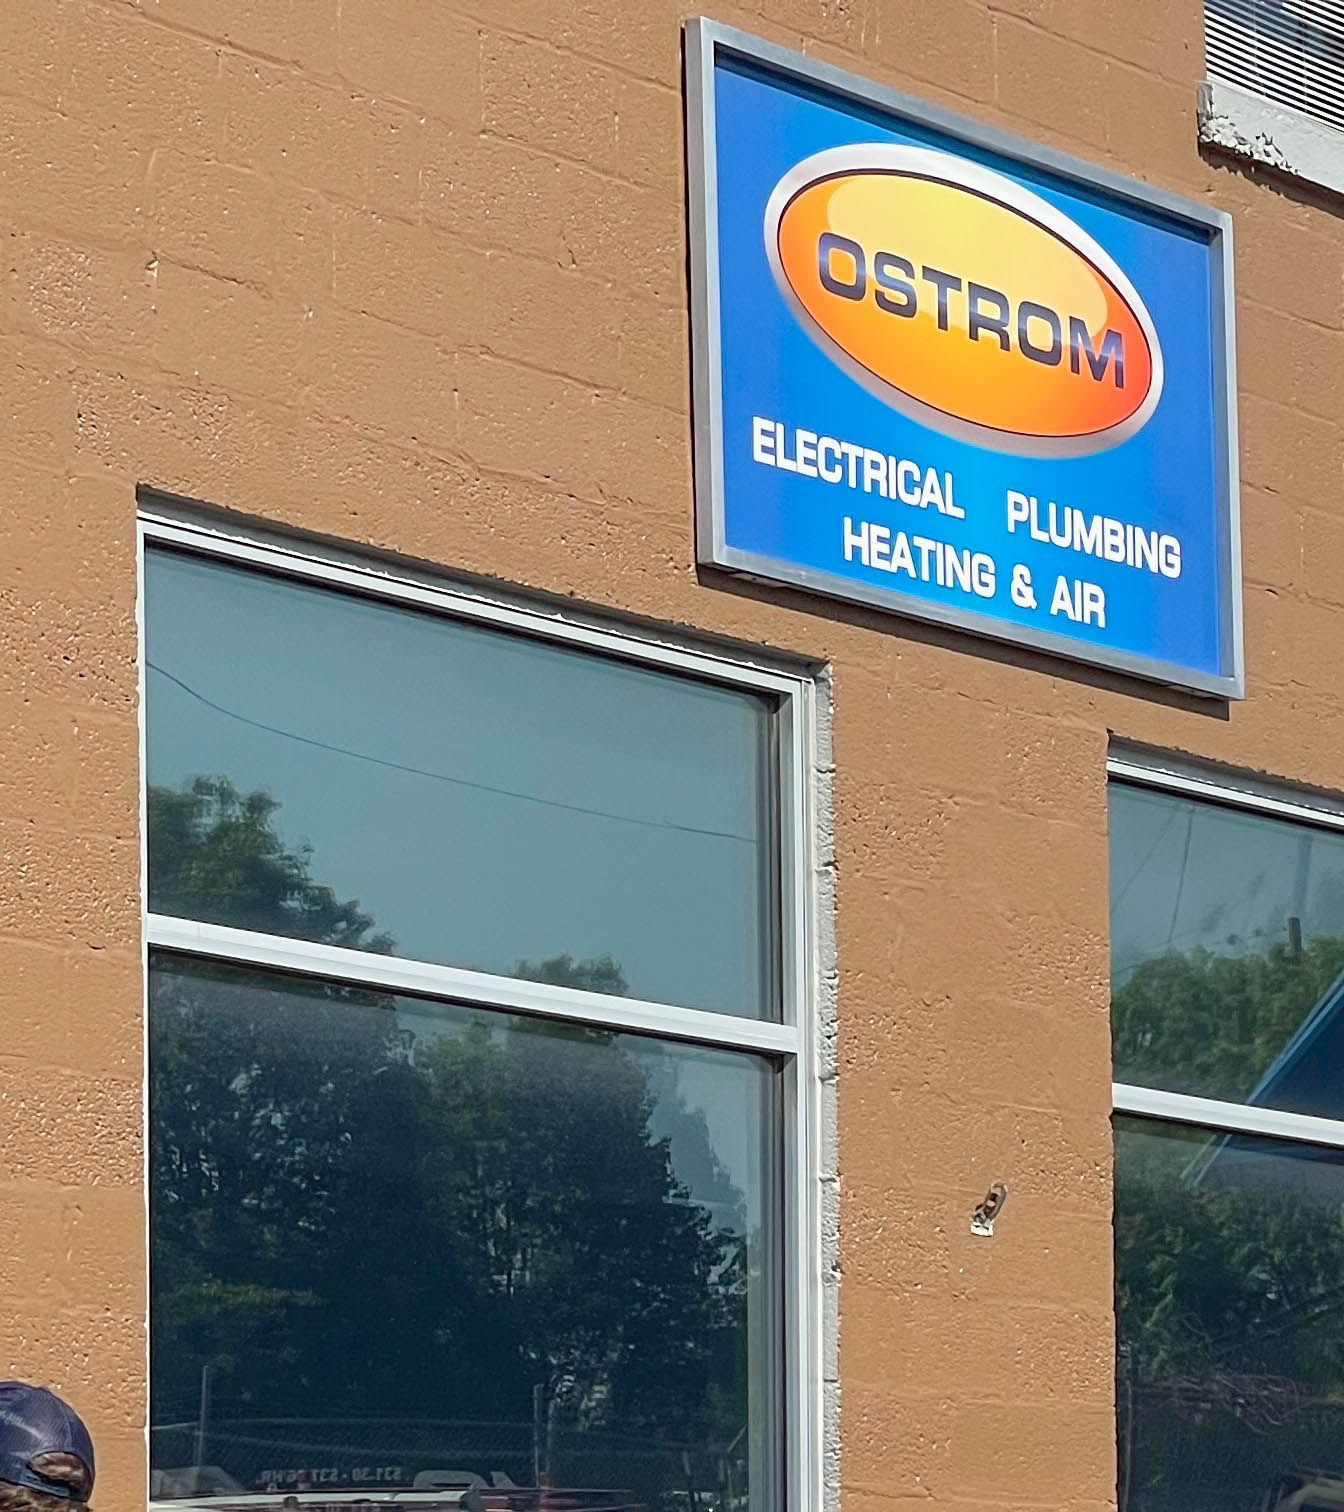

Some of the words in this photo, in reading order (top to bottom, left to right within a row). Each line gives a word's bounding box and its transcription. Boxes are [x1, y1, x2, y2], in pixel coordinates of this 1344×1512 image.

[818, 232, 1125, 389] OSTROM
[752, 416, 966, 520] ELECTRICAL
[1006, 489, 1182, 580] PLUMBING
[843, 516, 996, 598] HEATING
[1010, 563, 1038, 610] &
[1049, 575, 1106, 628] AIR
